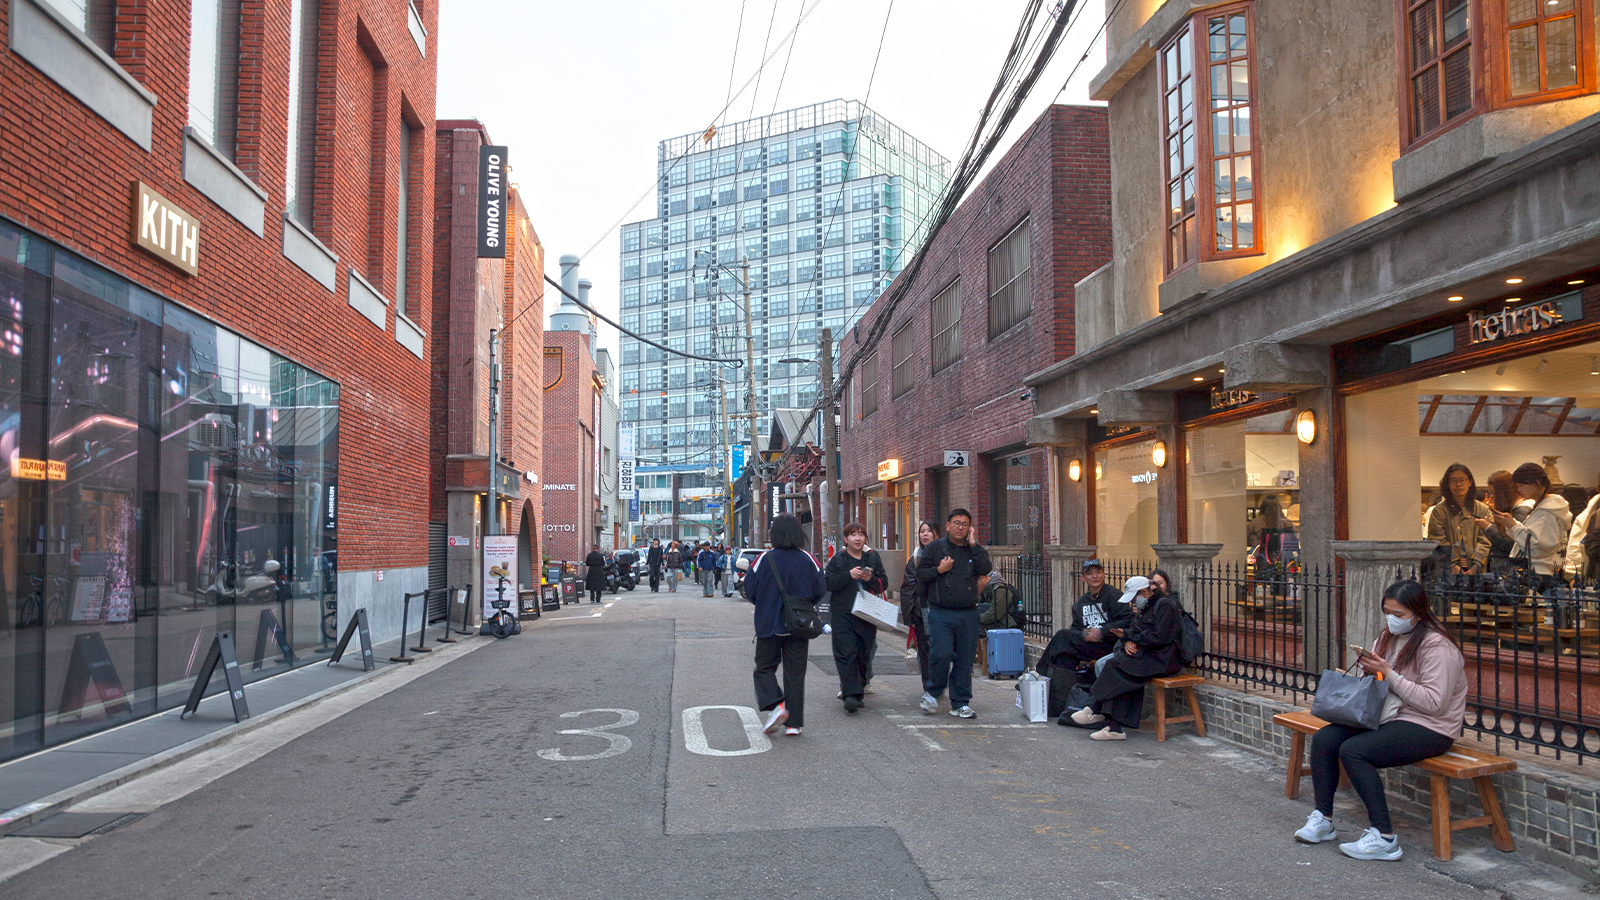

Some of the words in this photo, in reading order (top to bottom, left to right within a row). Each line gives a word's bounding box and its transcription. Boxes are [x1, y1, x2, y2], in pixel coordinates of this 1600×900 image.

[488, 154, 500, 196] OLIVE
[142, 193, 197, 267] KITH
[486, 199, 499, 248] YOUNG
[621, 461, 632, 492] 진영합지
[536, 704, 773, 761] 30
